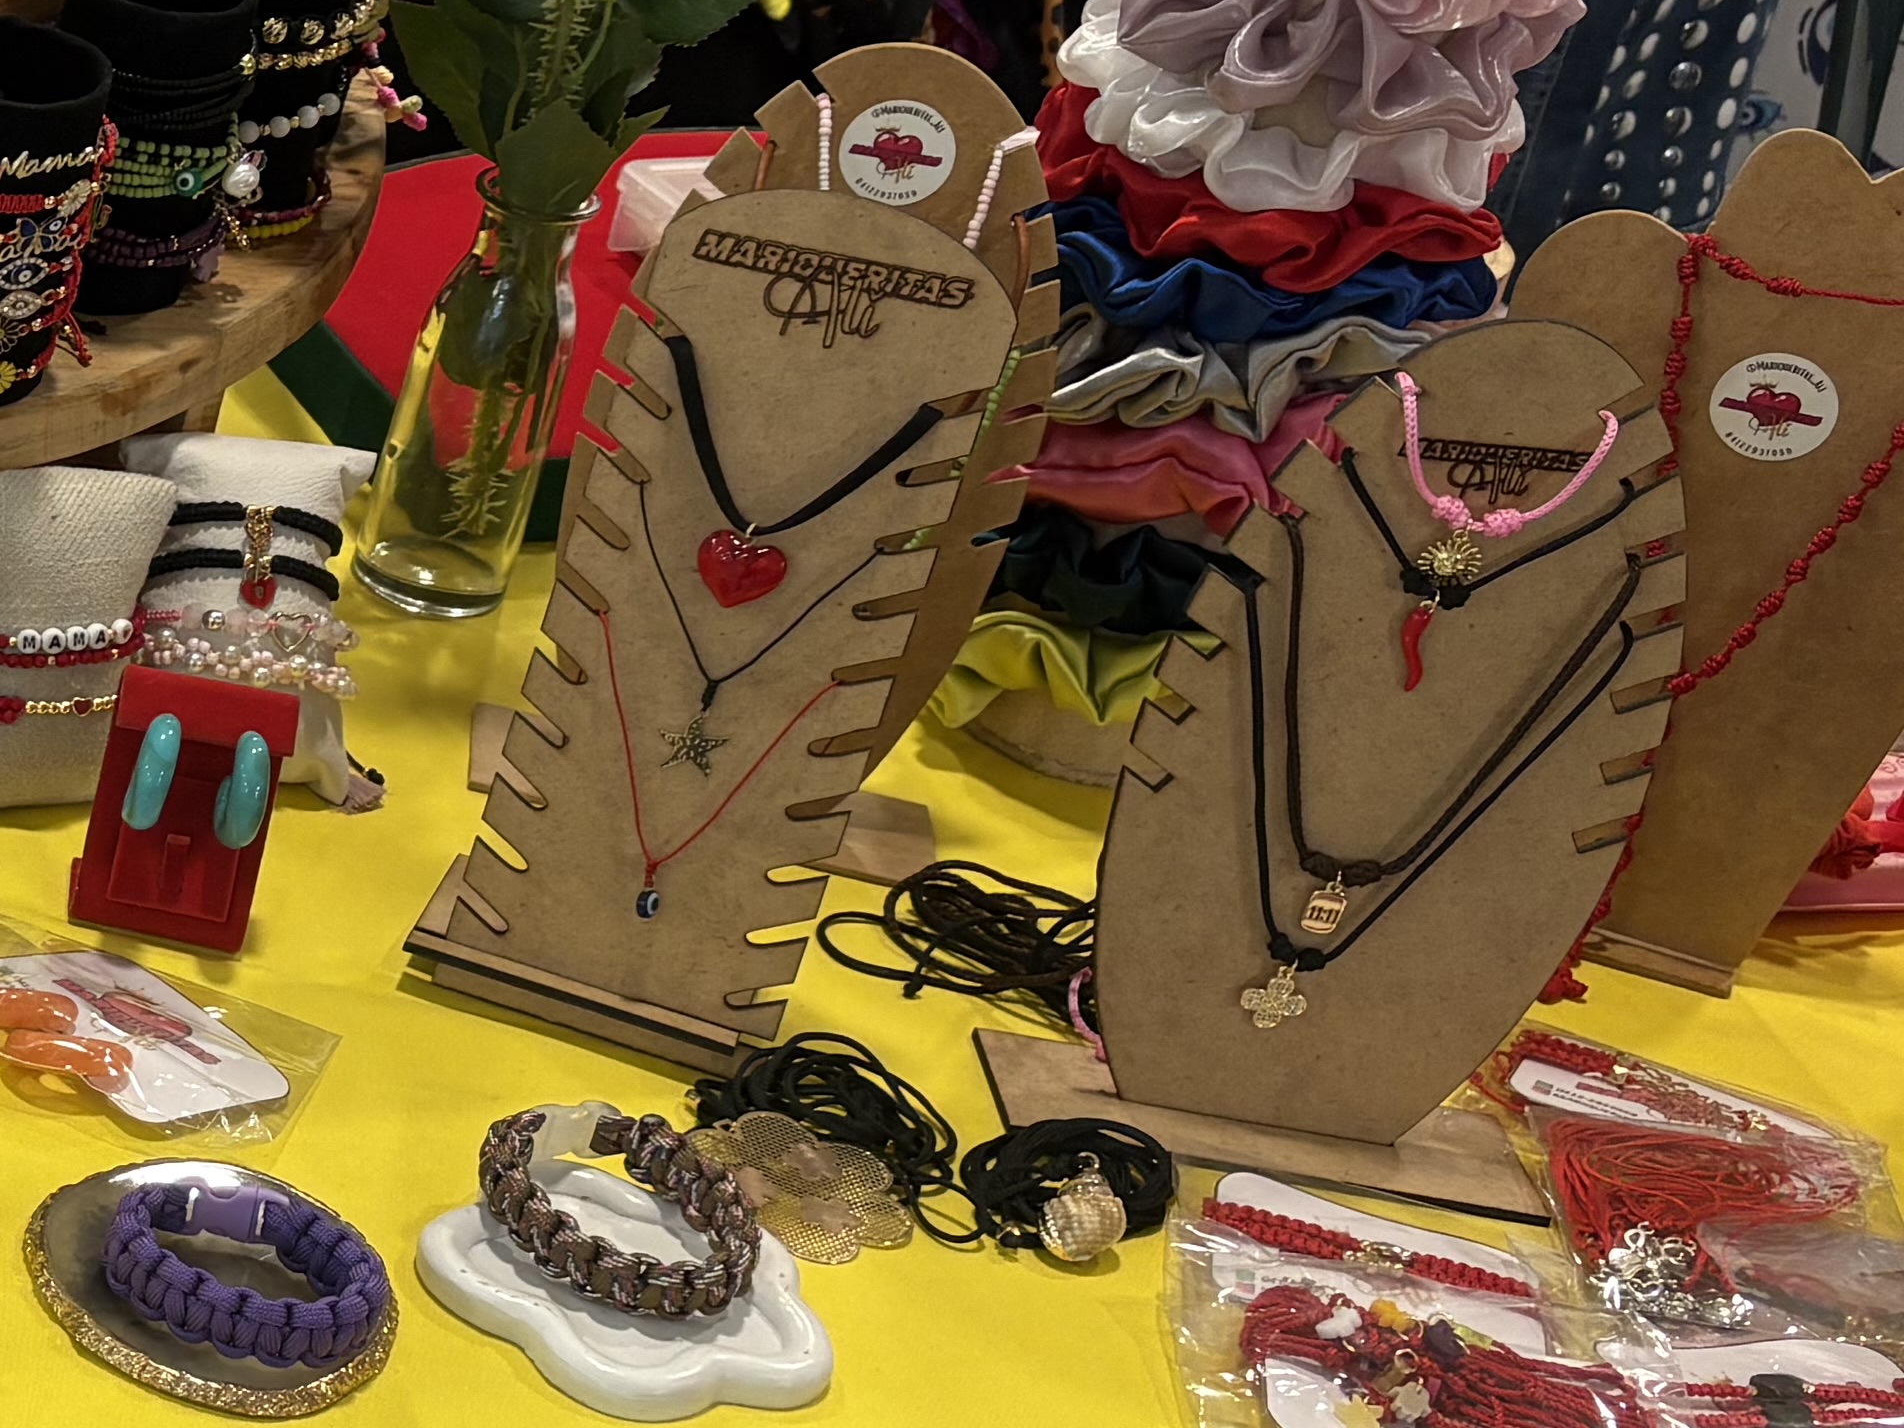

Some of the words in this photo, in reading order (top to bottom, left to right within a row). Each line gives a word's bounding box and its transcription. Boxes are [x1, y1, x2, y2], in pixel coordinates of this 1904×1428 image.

[692, 228, 975, 309] MARIQUERITAS
[22, 631, 108, 651] MAMA
[1308, 905, 1340, 924] 11:11
